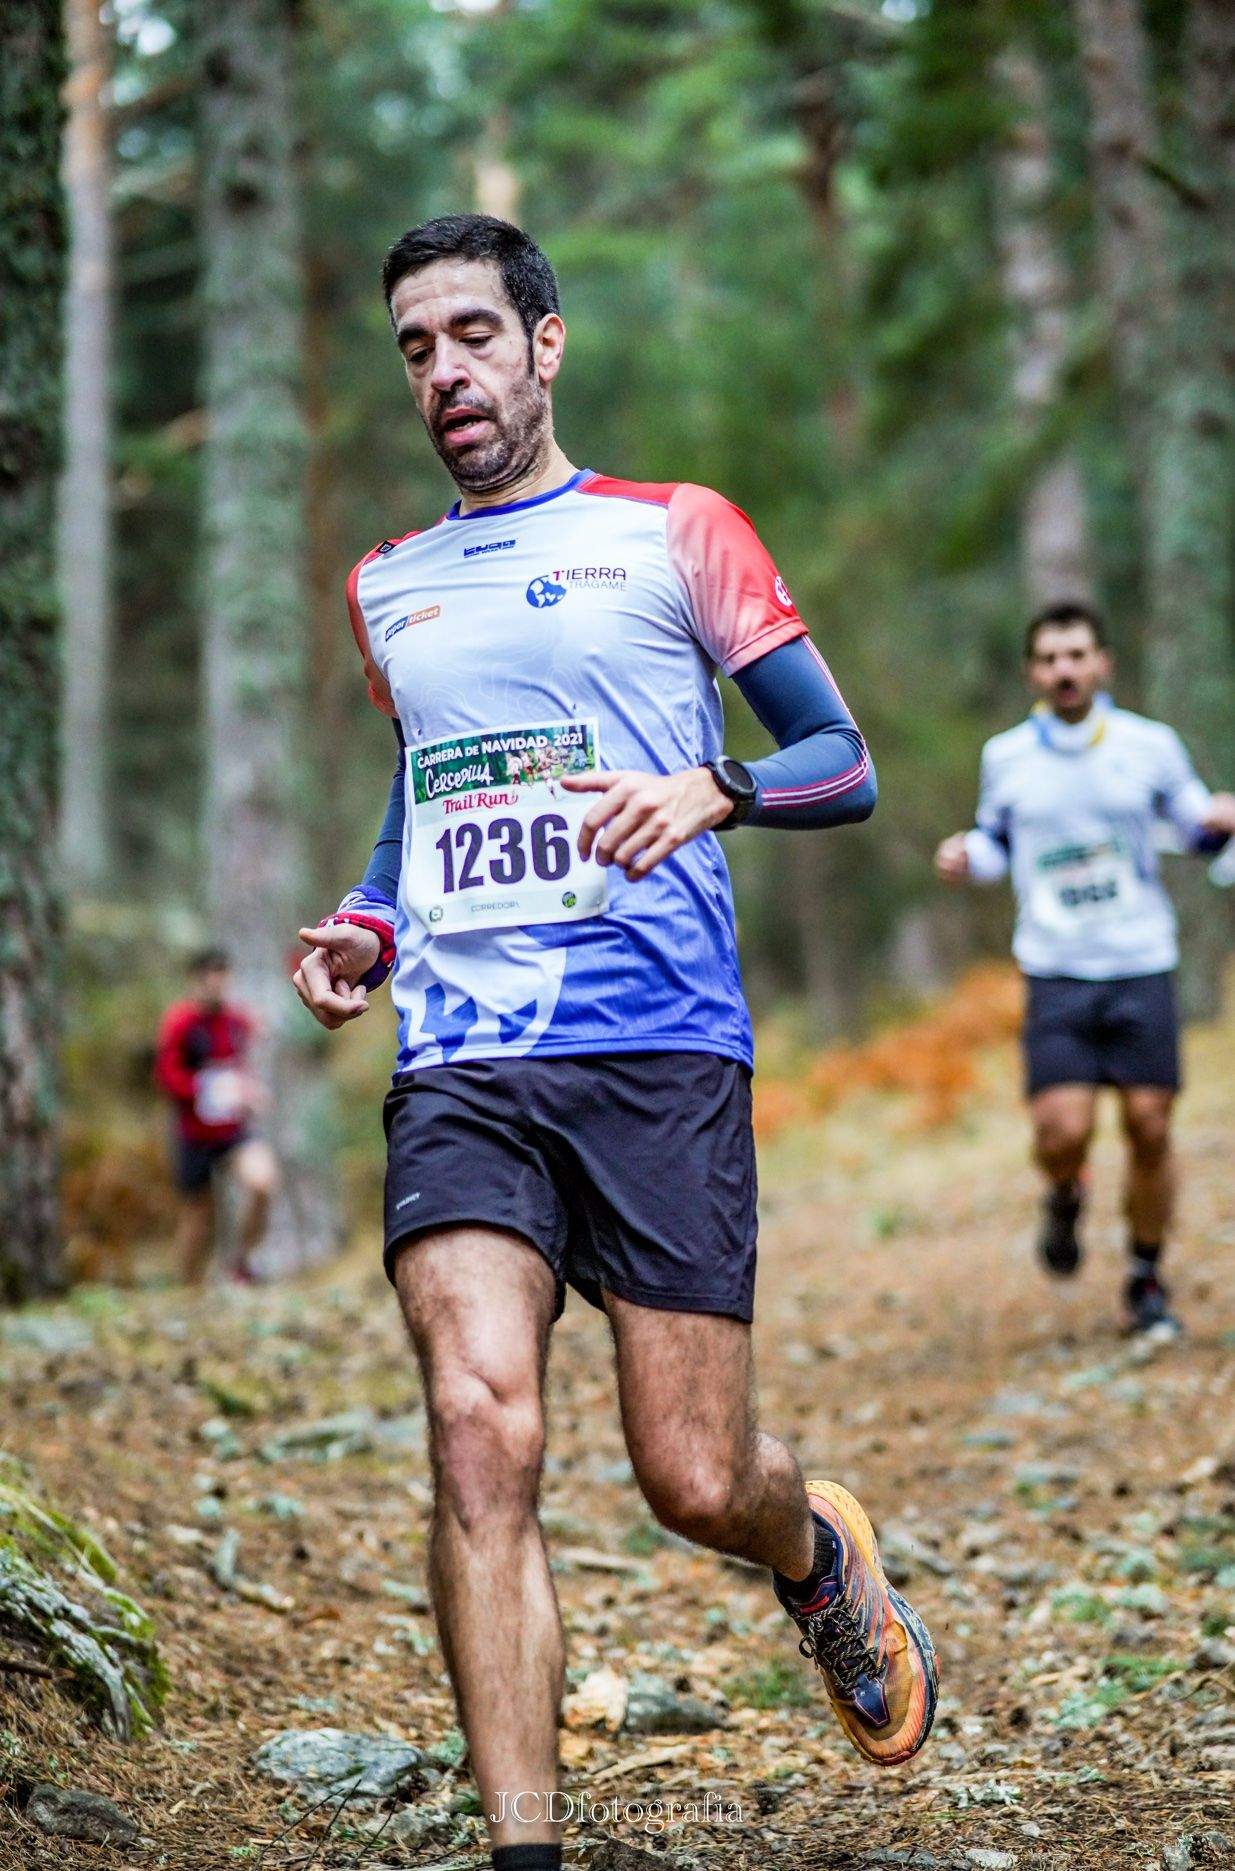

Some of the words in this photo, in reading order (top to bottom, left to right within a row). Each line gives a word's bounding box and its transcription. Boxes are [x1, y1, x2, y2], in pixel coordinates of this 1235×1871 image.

[553, 567, 626, 581] TIERRA
[569, 580, 627, 592] TRAGAME
[417, 748, 463, 769] CARRERA
[465, 746, 479, 756] DE
[482, 735, 548, 754] NAVIDAD
[553, 732, 583, 747] 2021
[443, 794, 473, 815] Trail
[435, 813, 571, 894] 1236
